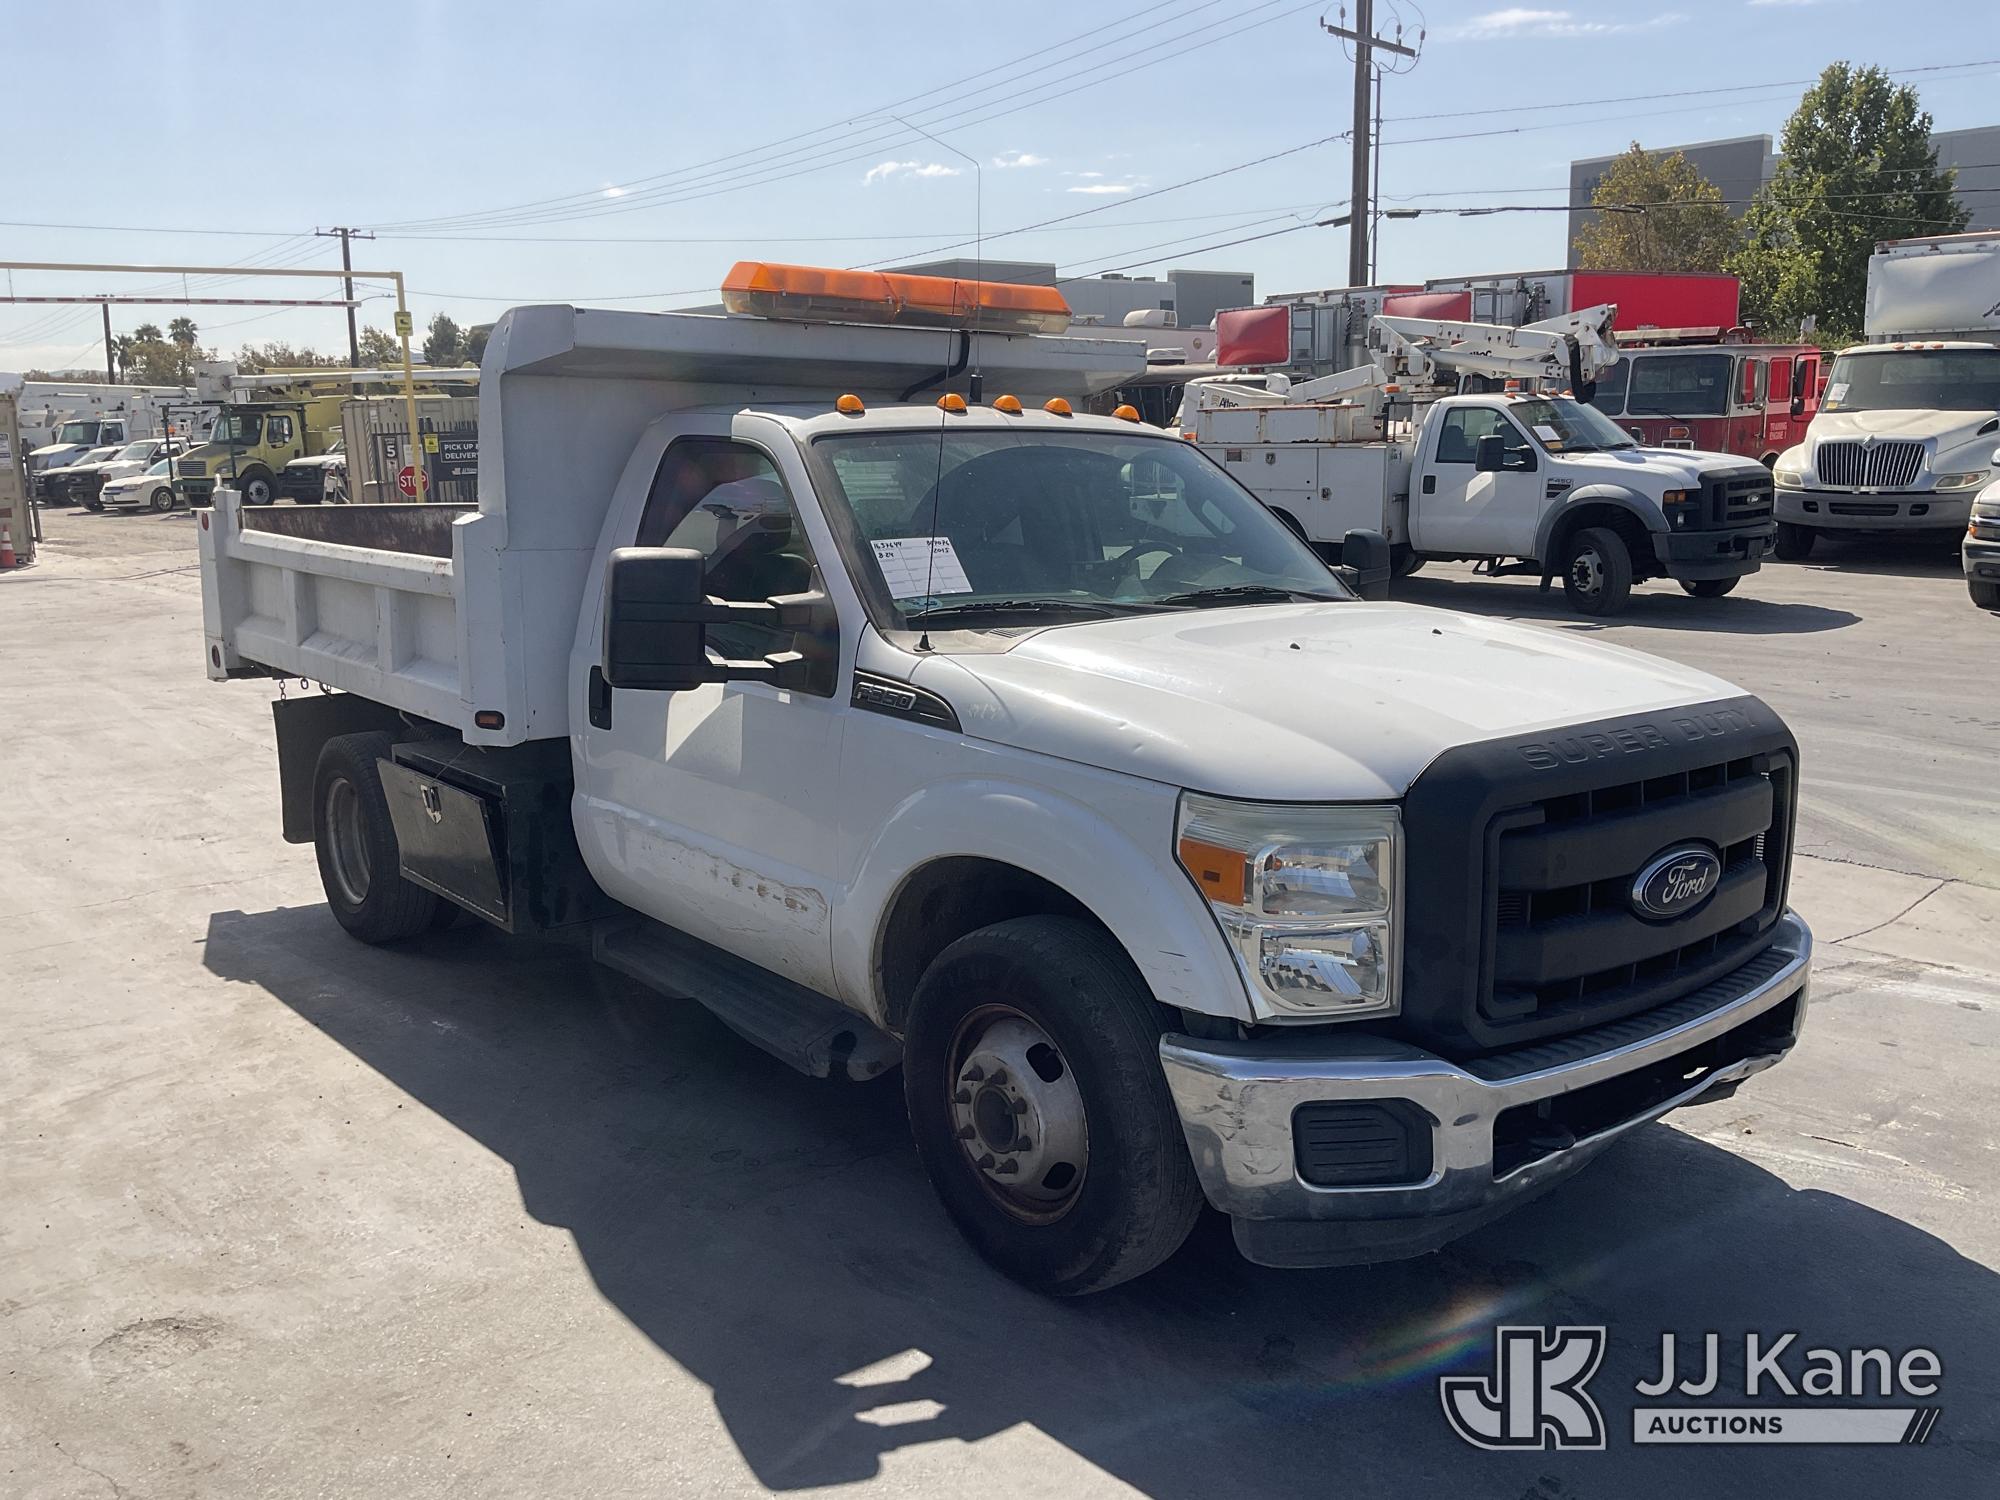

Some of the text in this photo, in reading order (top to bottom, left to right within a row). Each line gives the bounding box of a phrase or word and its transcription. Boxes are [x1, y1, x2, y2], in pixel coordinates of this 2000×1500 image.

[386, 445, 396, 457] 5
[444, 443, 461, 451] PICK
[1517, 706, 1757, 770] SUPER DUTY
[1662, 862, 1709, 904] Ford
